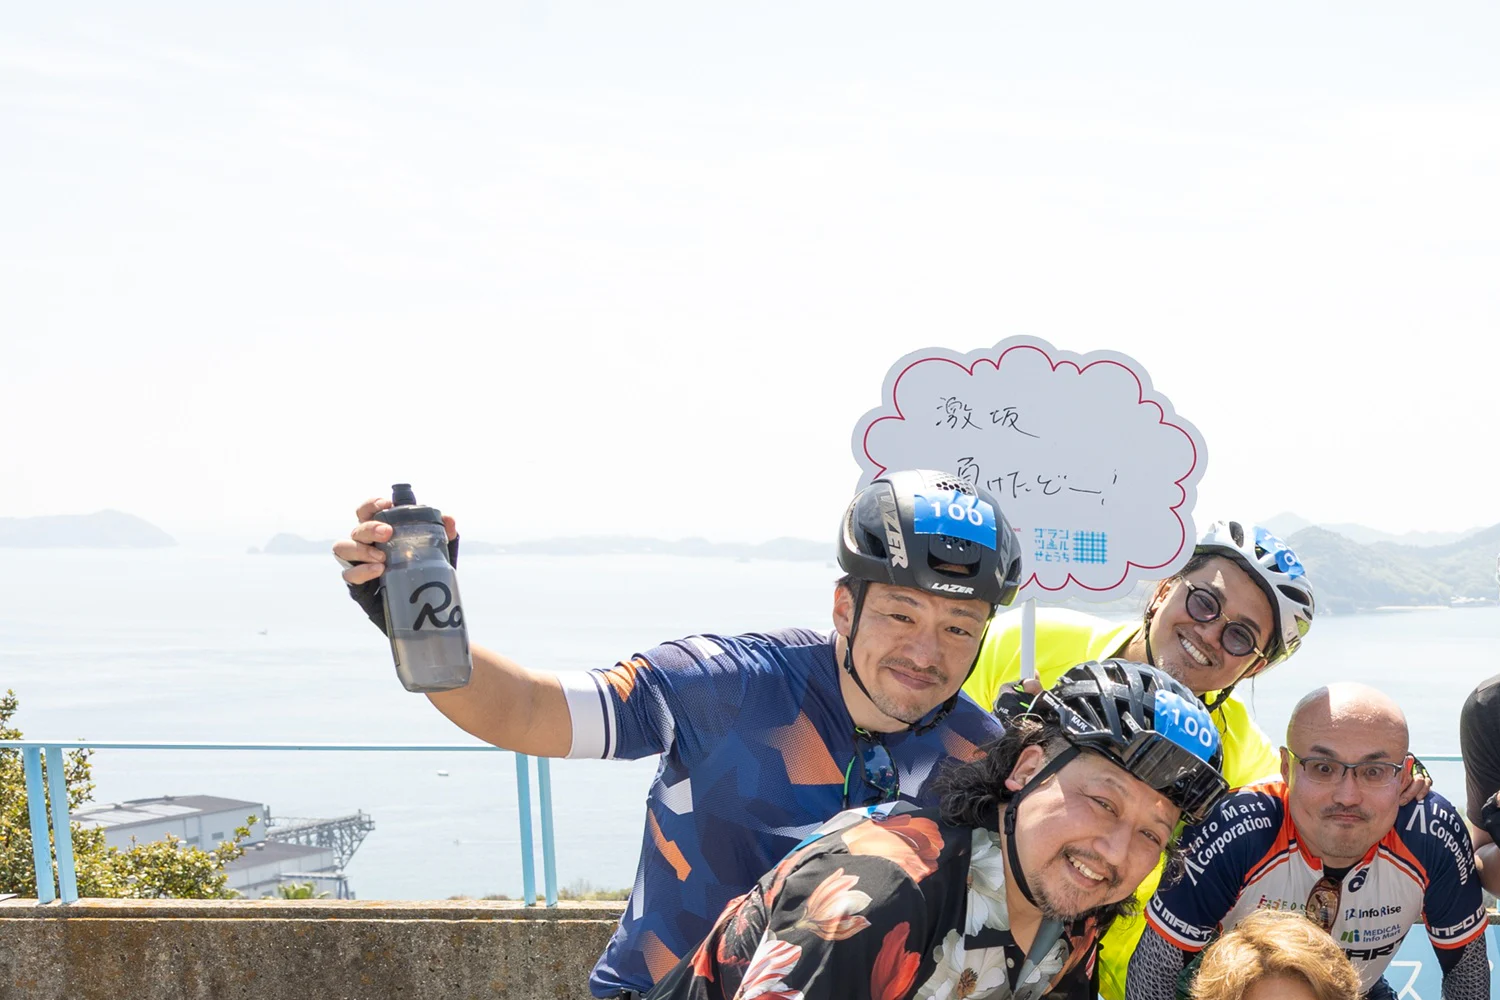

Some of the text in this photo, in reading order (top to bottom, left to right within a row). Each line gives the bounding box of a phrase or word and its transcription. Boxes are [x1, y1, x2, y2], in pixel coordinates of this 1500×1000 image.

[931, 502, 983, 526] 100
[931, 582, 974, 595] LAZER
[1172, 708, 1212, 748] 100
[1188, 801, 1266, 854] Info Mart
[1432, 803, 1460, 833] Info
[1197, 815, 1272, 866] Corporation
[1429, 819, 1468, 886] Corporation
[1363, 924, 1401, 937] MEDICAL
[1431, 914, 1475, 937] INFO
